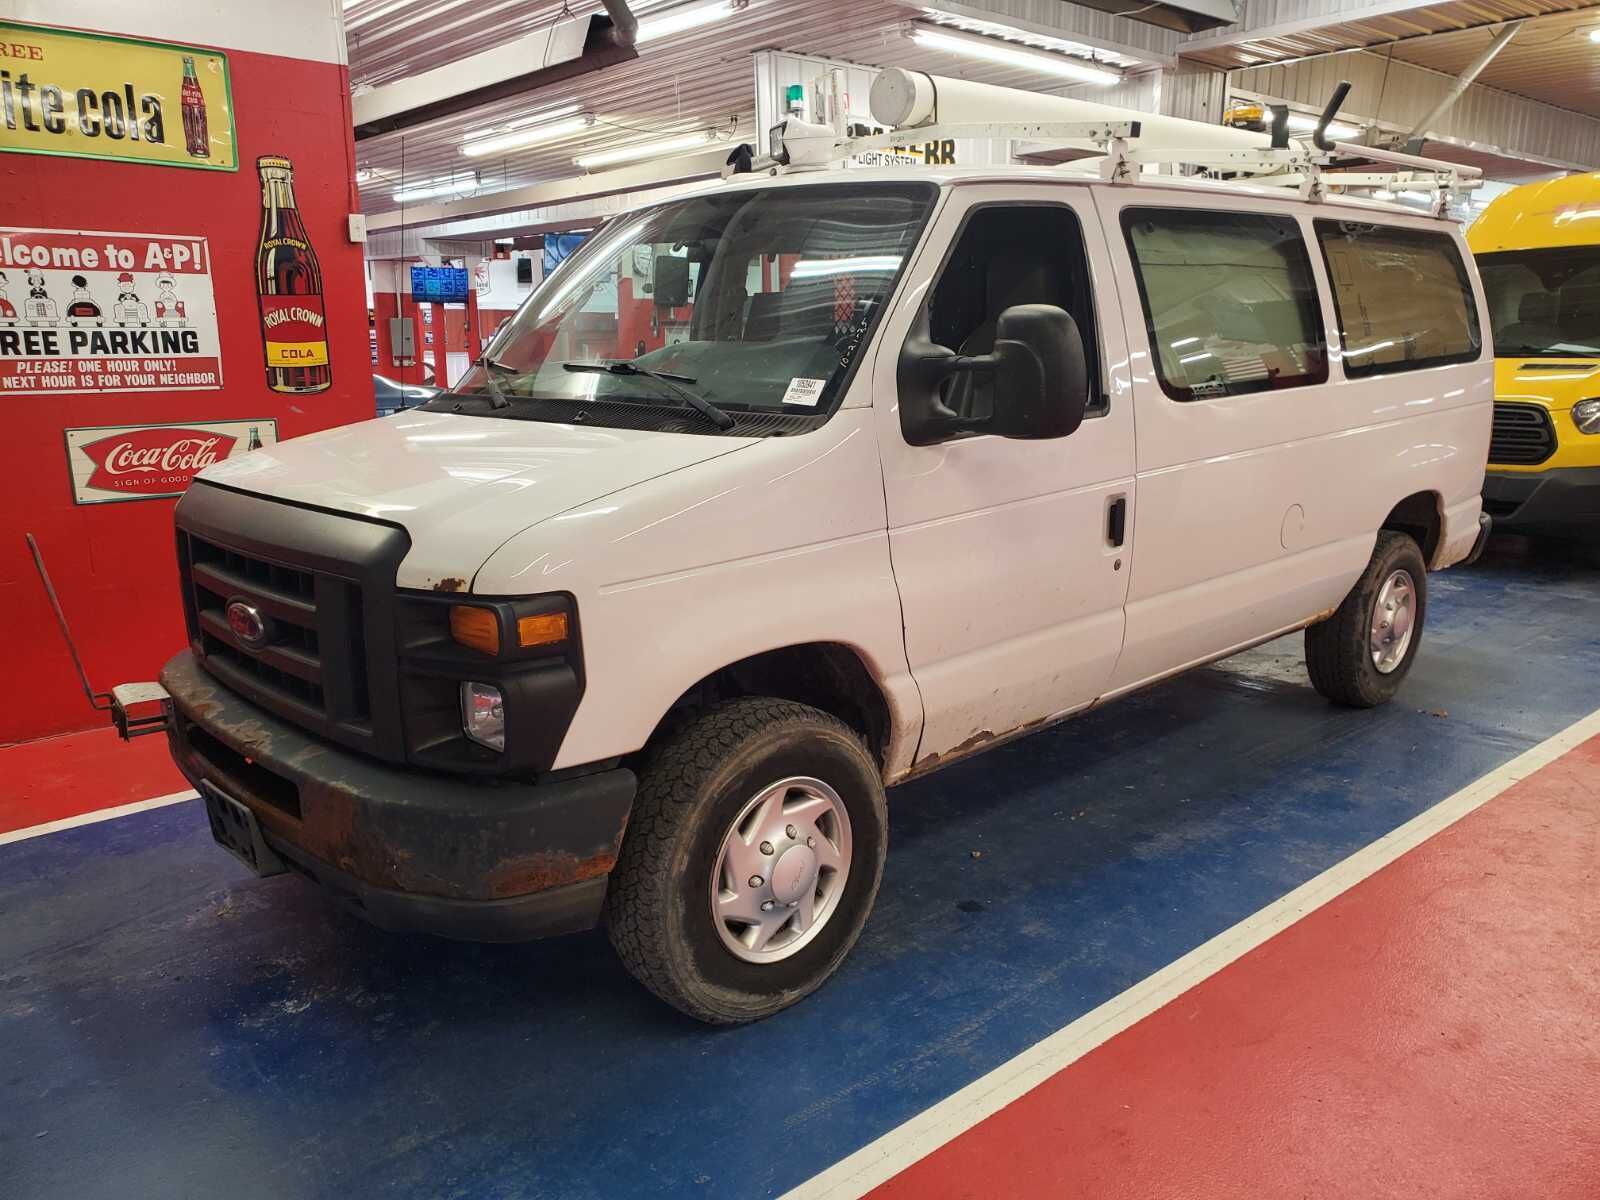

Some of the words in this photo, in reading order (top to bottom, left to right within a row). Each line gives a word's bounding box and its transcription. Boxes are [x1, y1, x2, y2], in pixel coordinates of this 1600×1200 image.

[76, 83, 165, 144] cola
[859, 152, 882, 166] LIGHT
[264, 238, 284, 250] ROYAL
[283, 237, 307, 251] CROWN
[0, 237, 99, 268] lcome
[104, 244, 135, 270] to
[144, 242, 202, 271] A&P!
[264, 307, 291, 329] ROYAL
[290, 307, 324, 328] CROWN
[0, 331, 60, 355] REE
[69, 330, 200, 355] PARKING
[281, 349, 314, 359] COLA
[16, 361, 73, 374] PLEASE!
[77, 362, 102, 372] ONE
[106, 361, 140, 373] HOUR
[143, 360, 177, 371] ONLY!
[2, 376, 37, 389] NEXT
[41, 375, 76, 388] HOUR
[81, 375, 94, 387] IS
[98, 374, 121, 387] FOR
[124, 374, 156, 386] YOUR
[160, 372, 216, 385] NEIGHBOR
[104, 436, 220, 475] Coca-Cola
[114, 479, 139, 487] SIGN
[160, 476, 188, 484] GOOD
